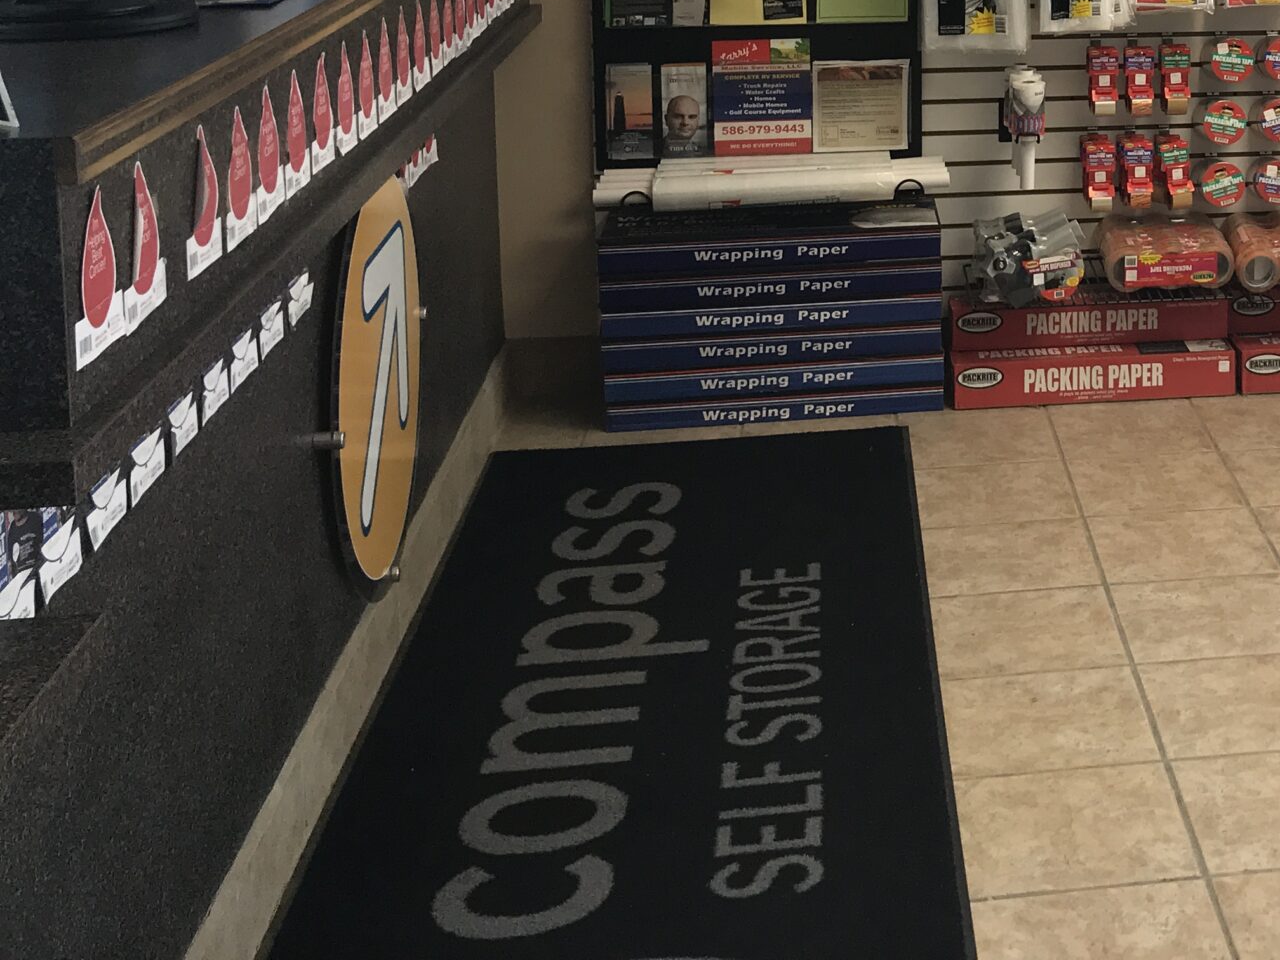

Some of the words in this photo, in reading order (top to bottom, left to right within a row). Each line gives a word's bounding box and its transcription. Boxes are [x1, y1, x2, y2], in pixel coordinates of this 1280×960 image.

[1213, 54, 1241, 65] PACKAGING
[1242, 57, 1254, 66] TAPE
[721, 123, 805, 136] 586-979-9443
[752, 141, 797, 149] EVERYTHING!
[694, 247, 783, 262] Wrapping
[797, 244, 848, 257] Paper
[695, 312, 785, 327] Wrapping
[798, 308, 849, 322] Paper
[961, 316, 998, 328] PACKRITE
[1026, 310, 1102, 335] PACKING
[1106, 308, 1159, 330] PAPER
[962, 371, 999, 384] PACKRITE
[1024, 366, 1103, 393] PACKING
[1108, 363, 1163, 388] PAPER
[702, 406, 791, 421] Wrapping
[804, 402, 855, 416] Paper
[724, 563, 823, 746] STORAGE
[430, 481, 710, 940] compass
[709, 761, 825, 899] SELF
